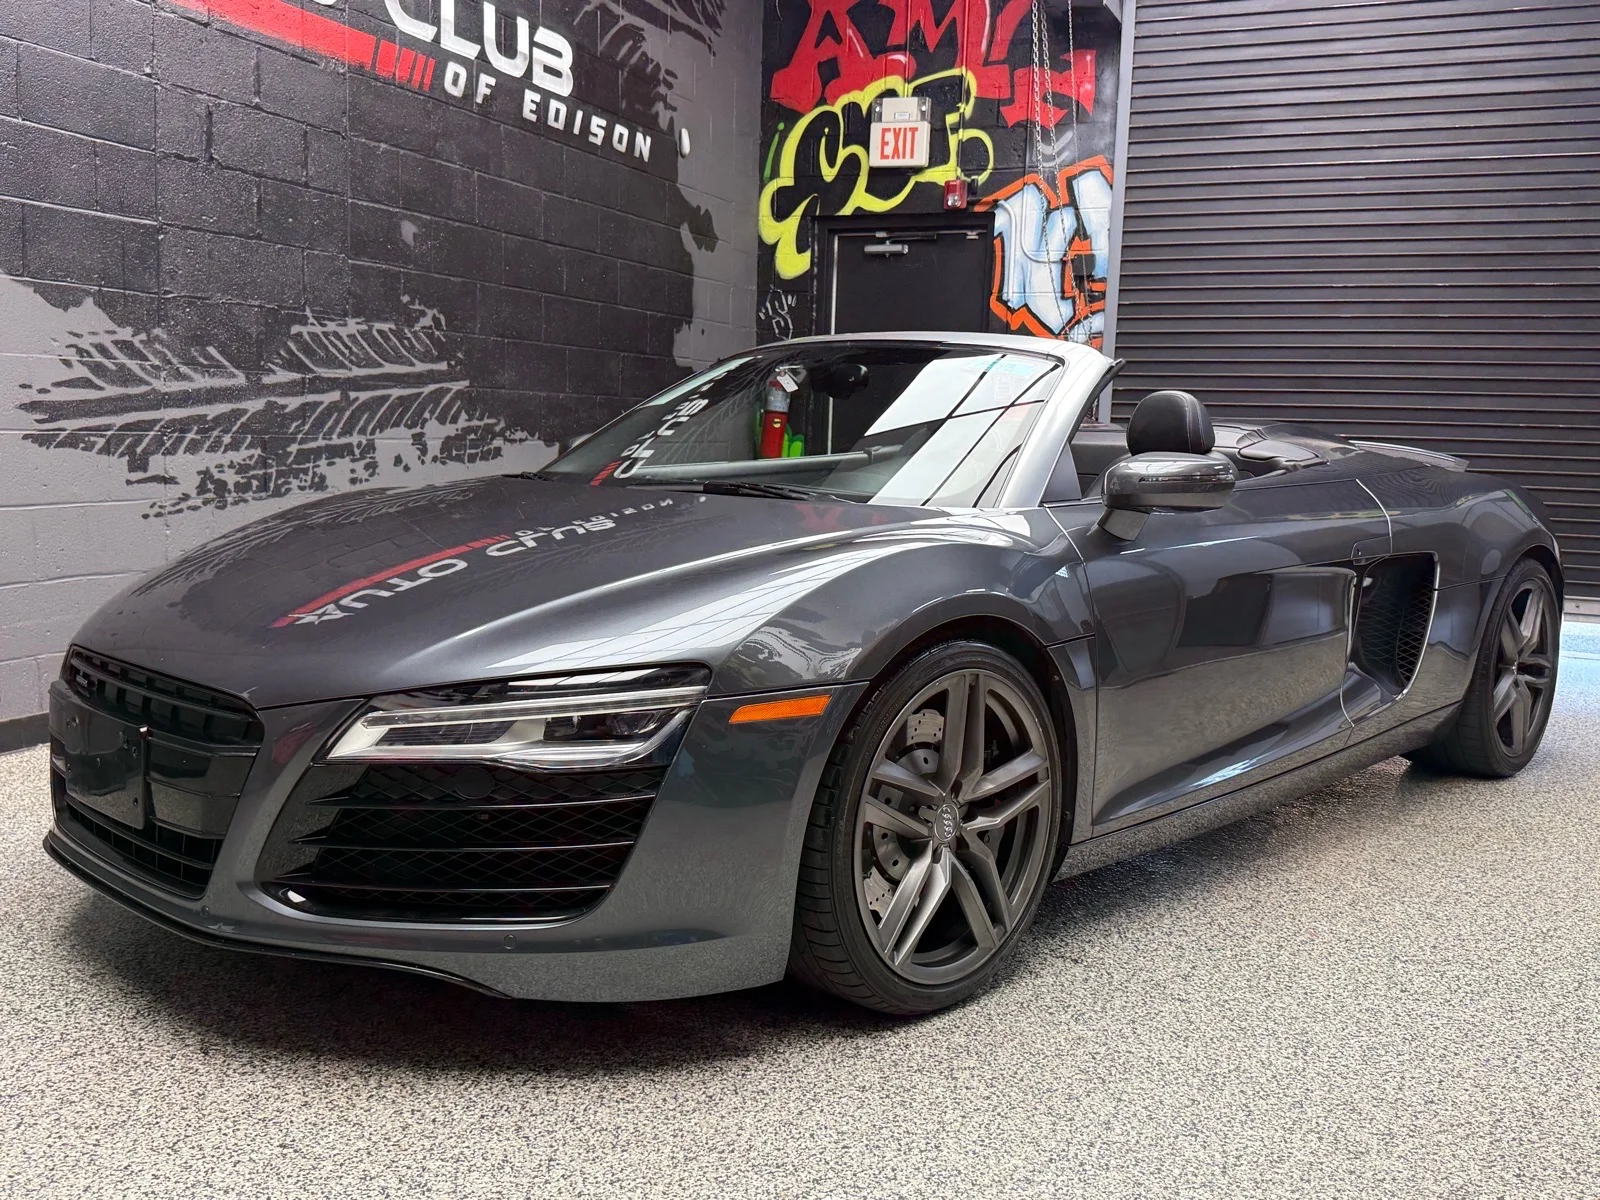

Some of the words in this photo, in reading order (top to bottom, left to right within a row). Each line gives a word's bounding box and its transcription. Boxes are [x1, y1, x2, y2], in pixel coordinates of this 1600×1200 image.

[444, 61, 497, 104] OF
[522, 88, 652, 163] EDISON
[880, 127, 919, 160] EXIT
